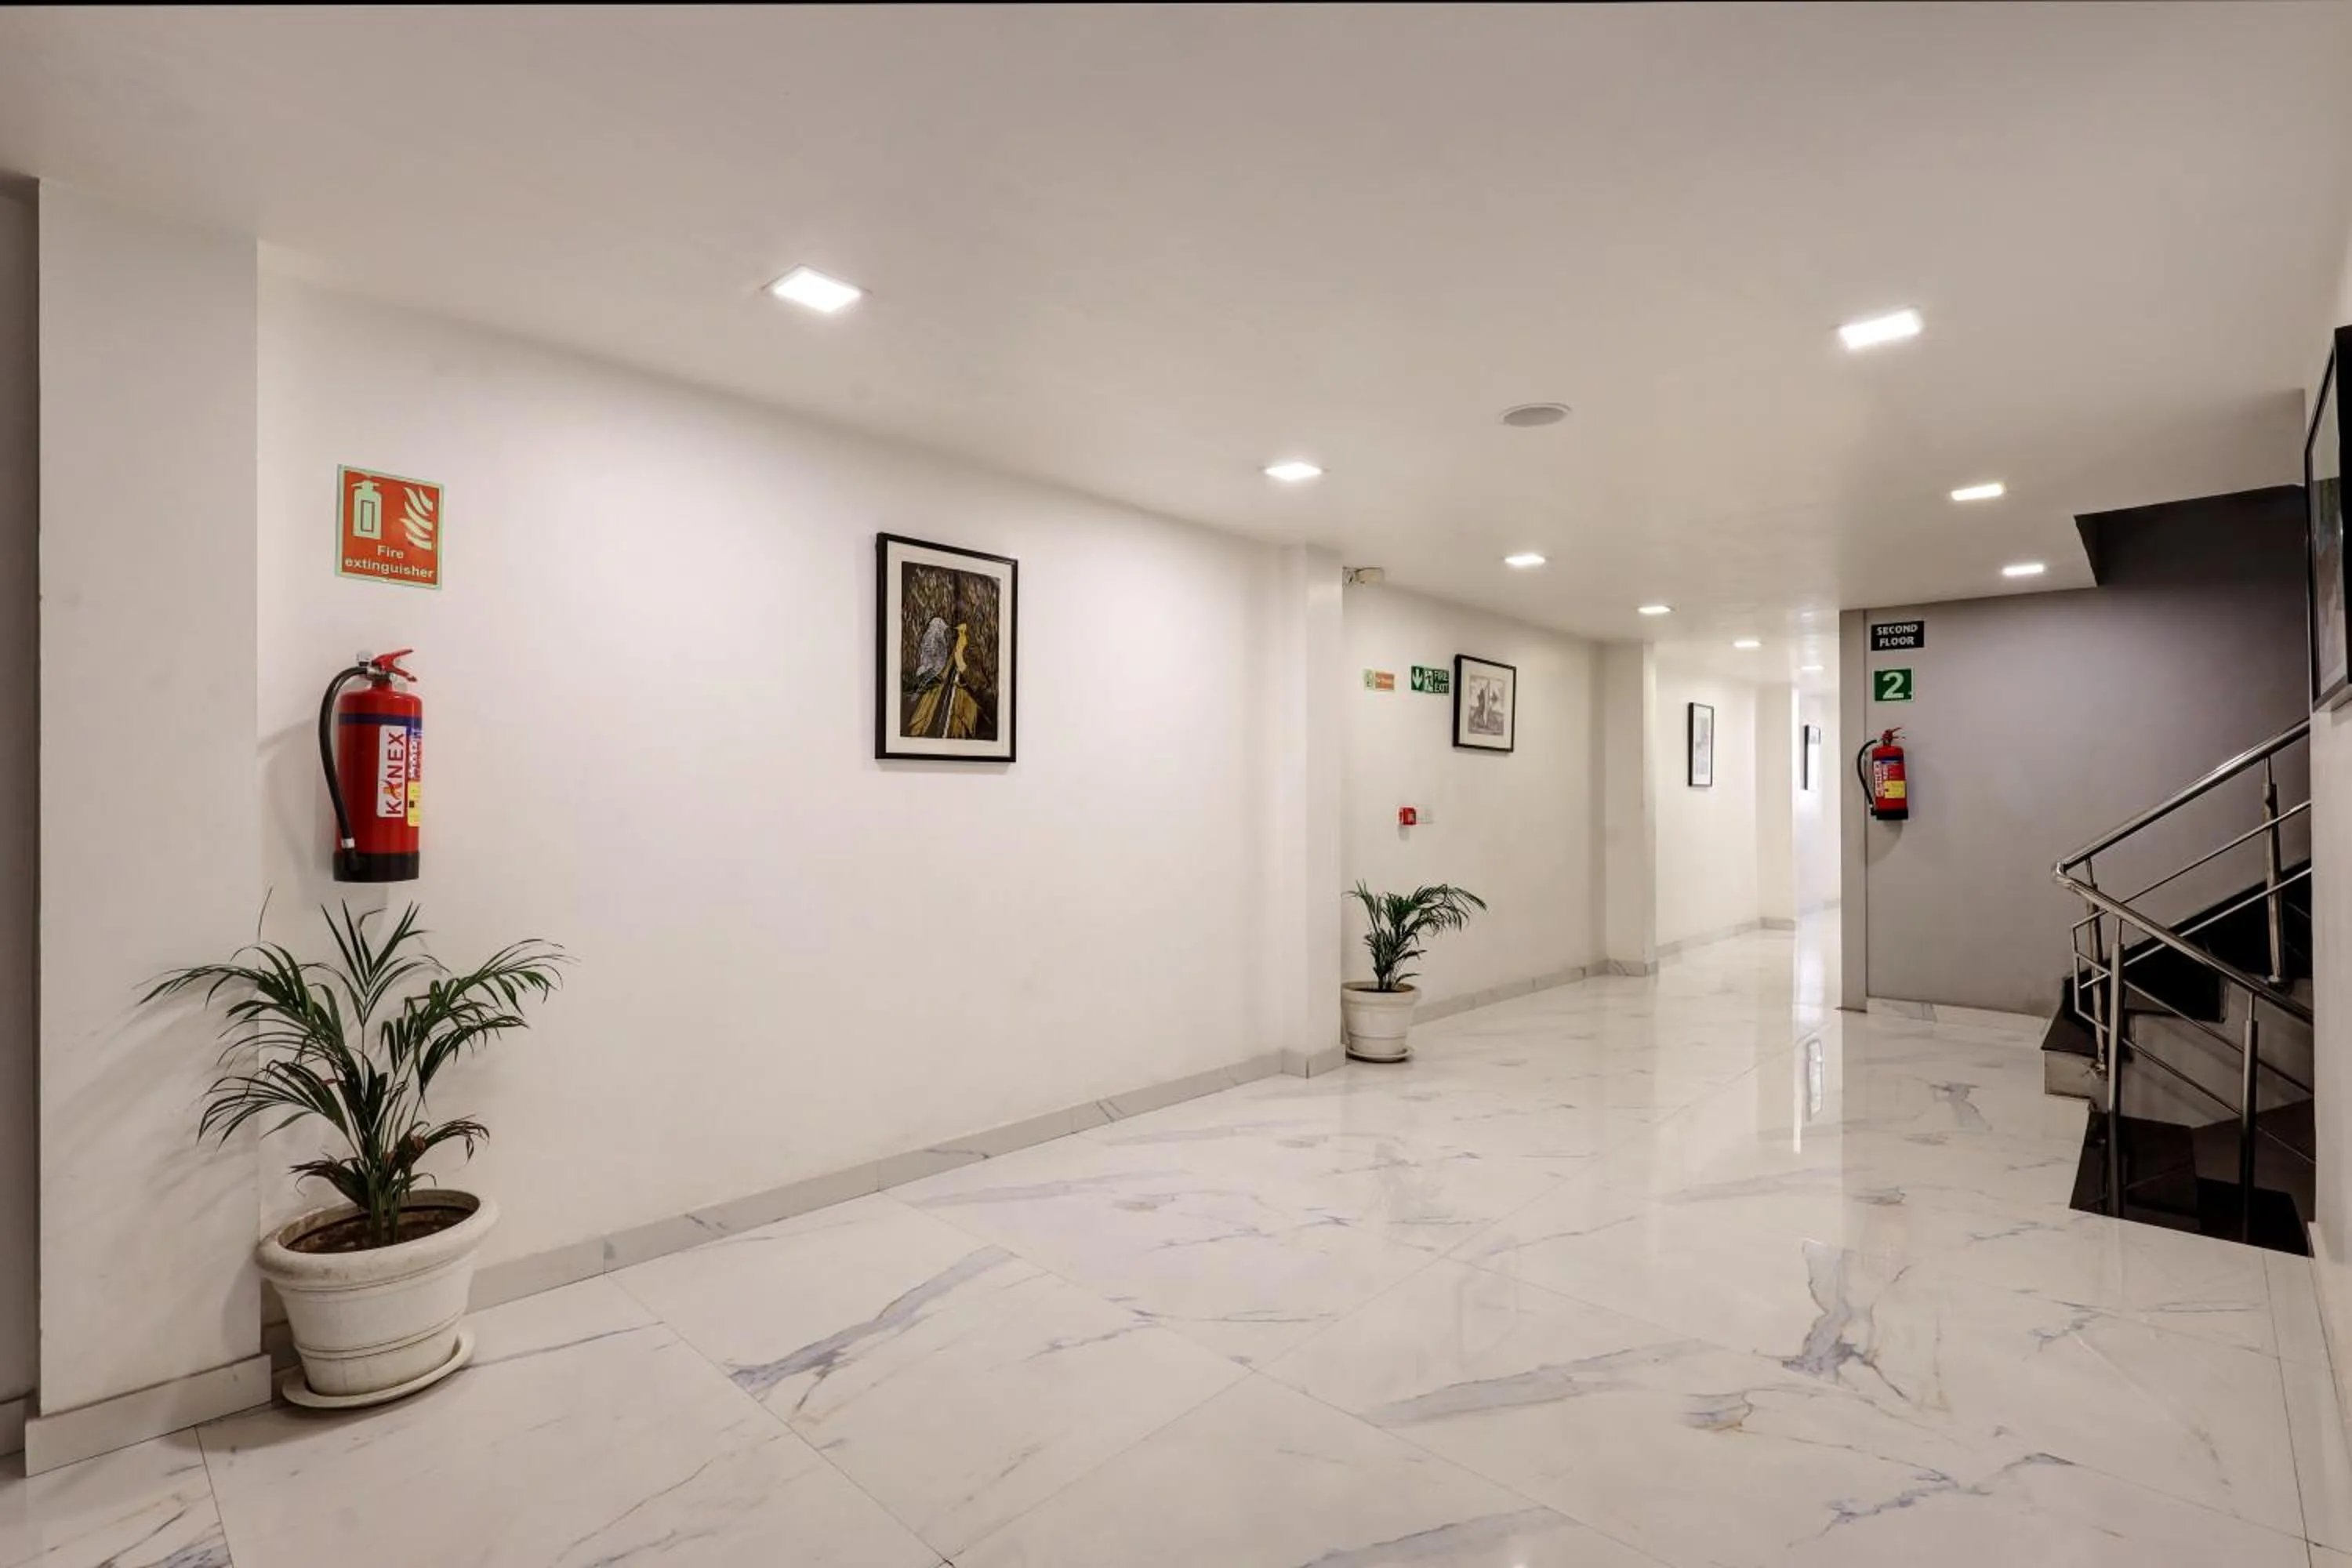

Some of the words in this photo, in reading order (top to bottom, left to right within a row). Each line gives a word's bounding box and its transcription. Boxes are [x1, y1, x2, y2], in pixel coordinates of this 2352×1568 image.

[377, 545, 405, 559] Fire
[345, 557, 434, 578] extinguisher
[1876, 624, 1918, 636] SECOND
[1879, 636, 1915, 647] FLOOR
[1434, 670, 1449, 681] FIRE
[1434, 682, 1449, 692] EXIT
[1882, 672, 1904, 699] 2
